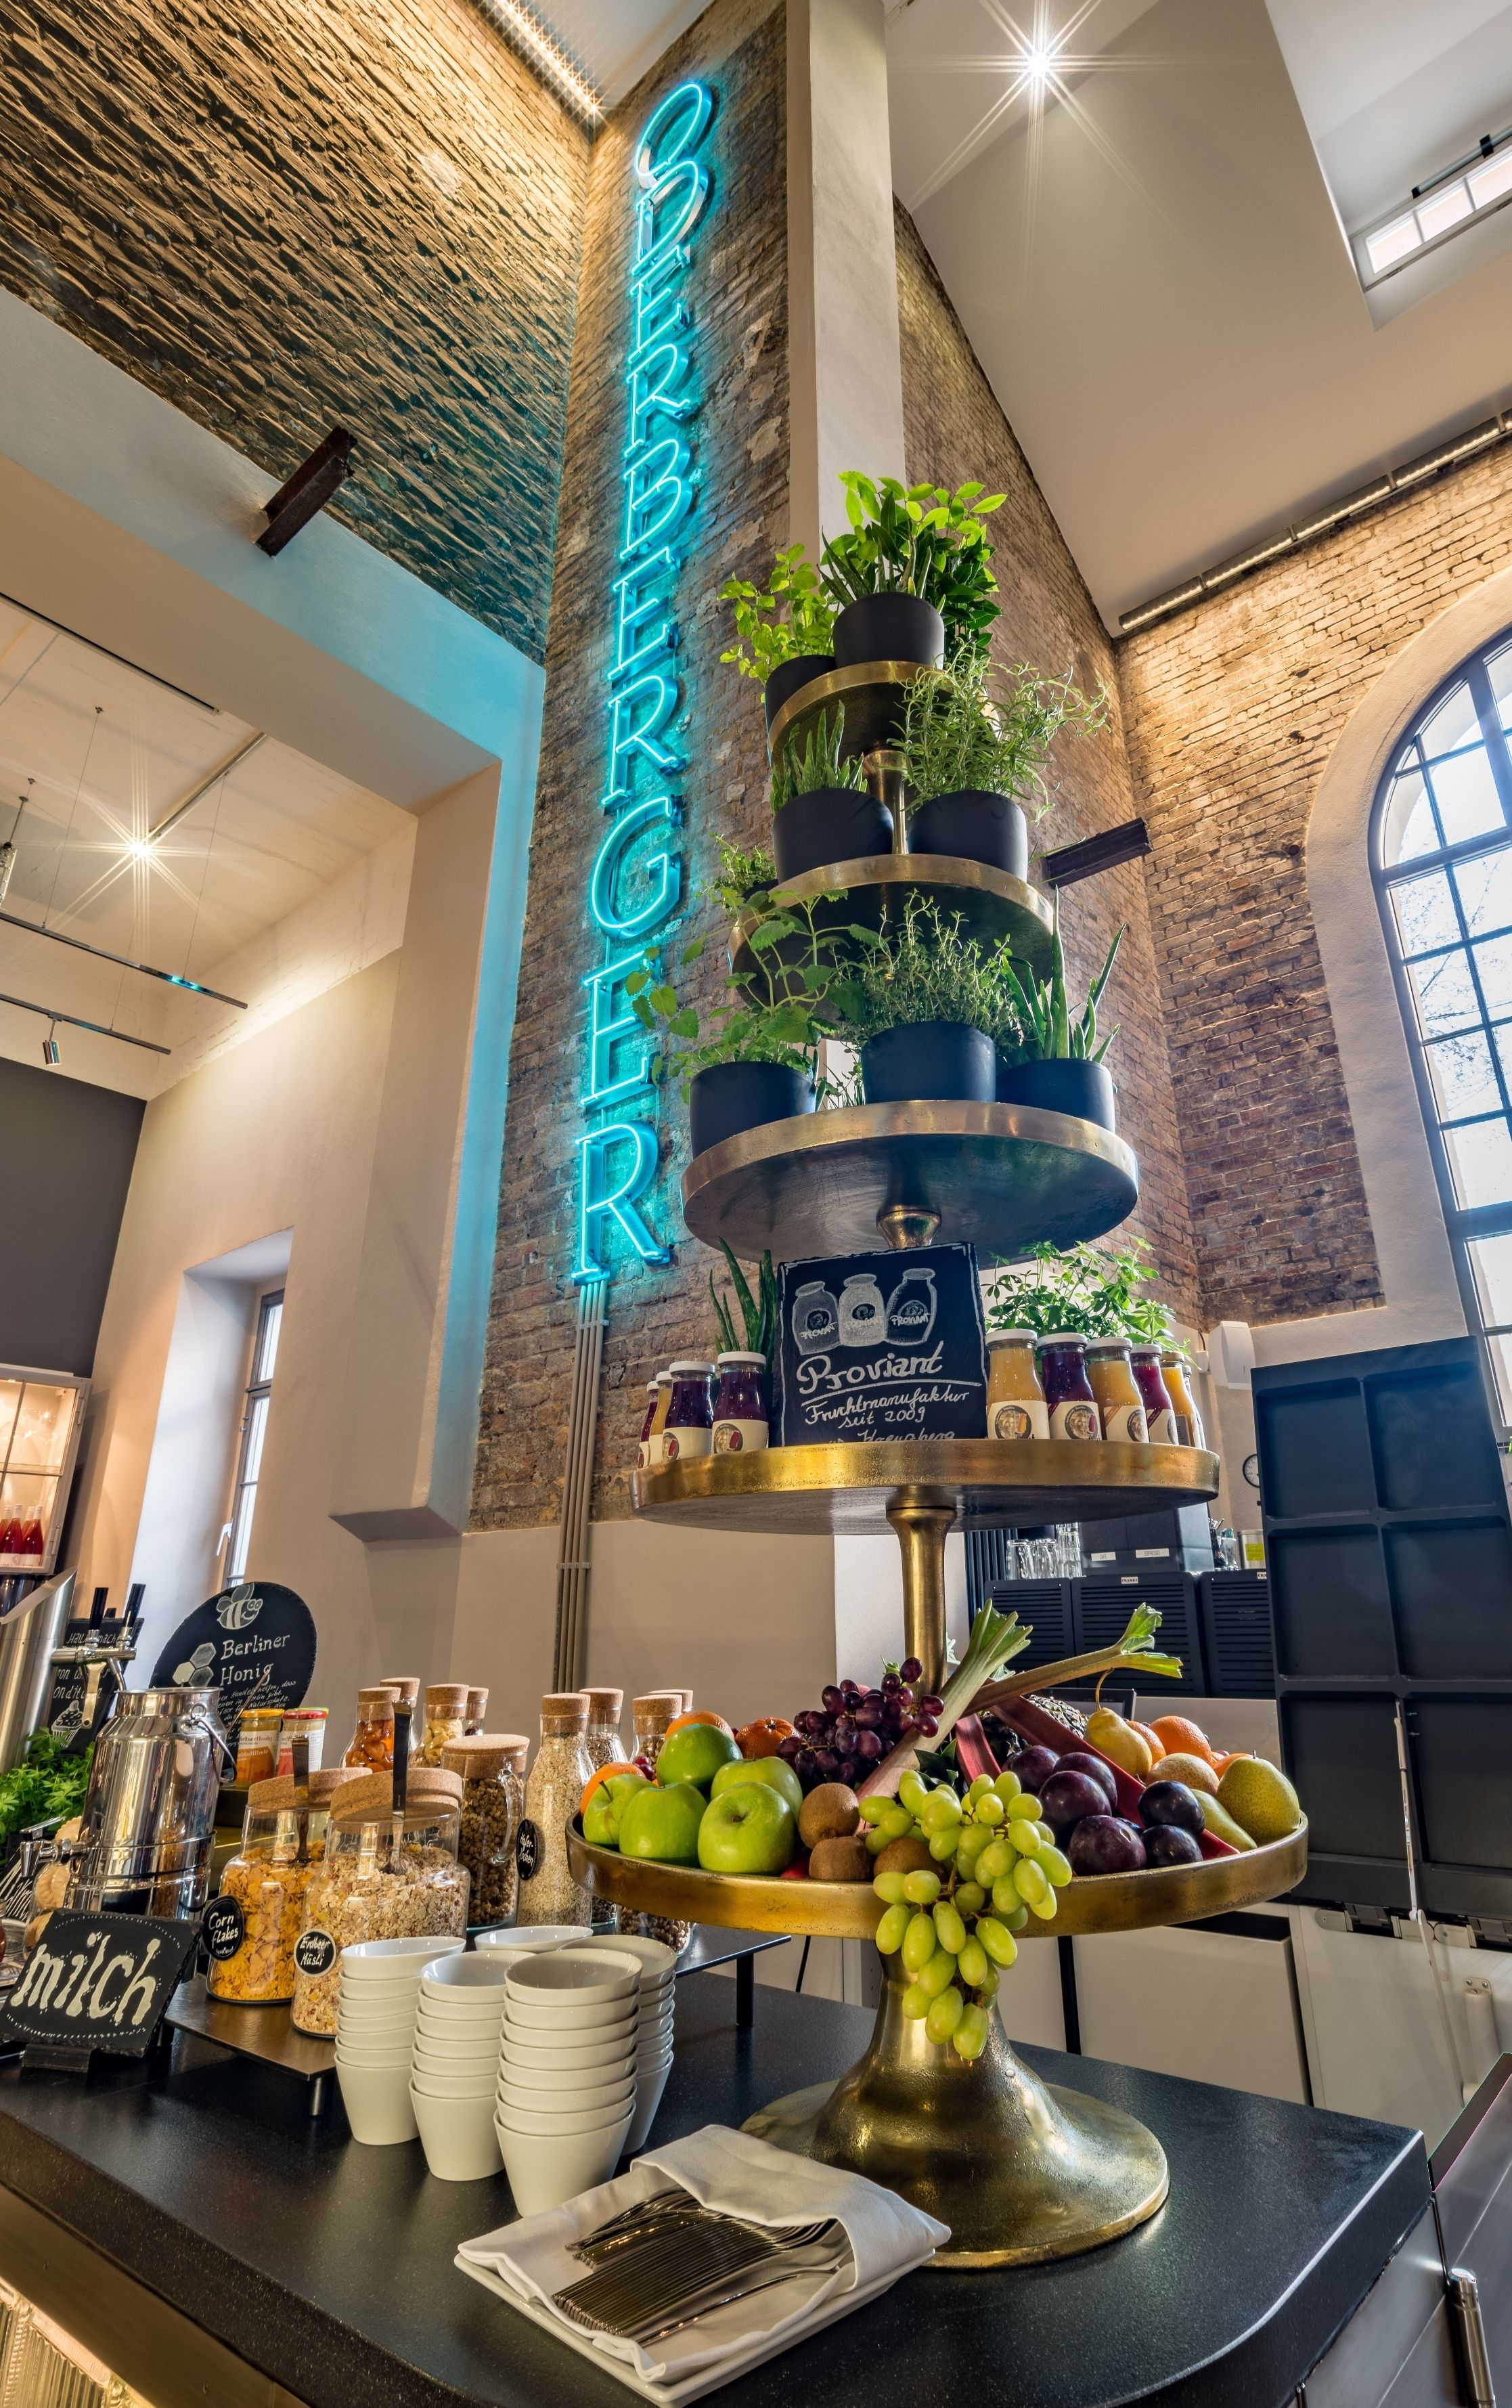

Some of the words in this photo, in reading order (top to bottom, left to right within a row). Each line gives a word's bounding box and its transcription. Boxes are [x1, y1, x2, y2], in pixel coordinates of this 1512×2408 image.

[571, 82, 709, 1281] ODERBERGER
[797, 1340, 944, 1395] Proviant
[805, 1384, 969, 1425] Fruchtmanufaktur
[838, 1412, 874, 1428] seit
[885, 1407, 925, 1422] 2009
[220, 1634, 290, 1661] Berliner
[219, 1663, 274, 1686] Honig
[208, 1912, 235, 1930] Corn
[299, 1935, 332, 1950] Erdbeer
[9, 1931, 162, 2027] milch
